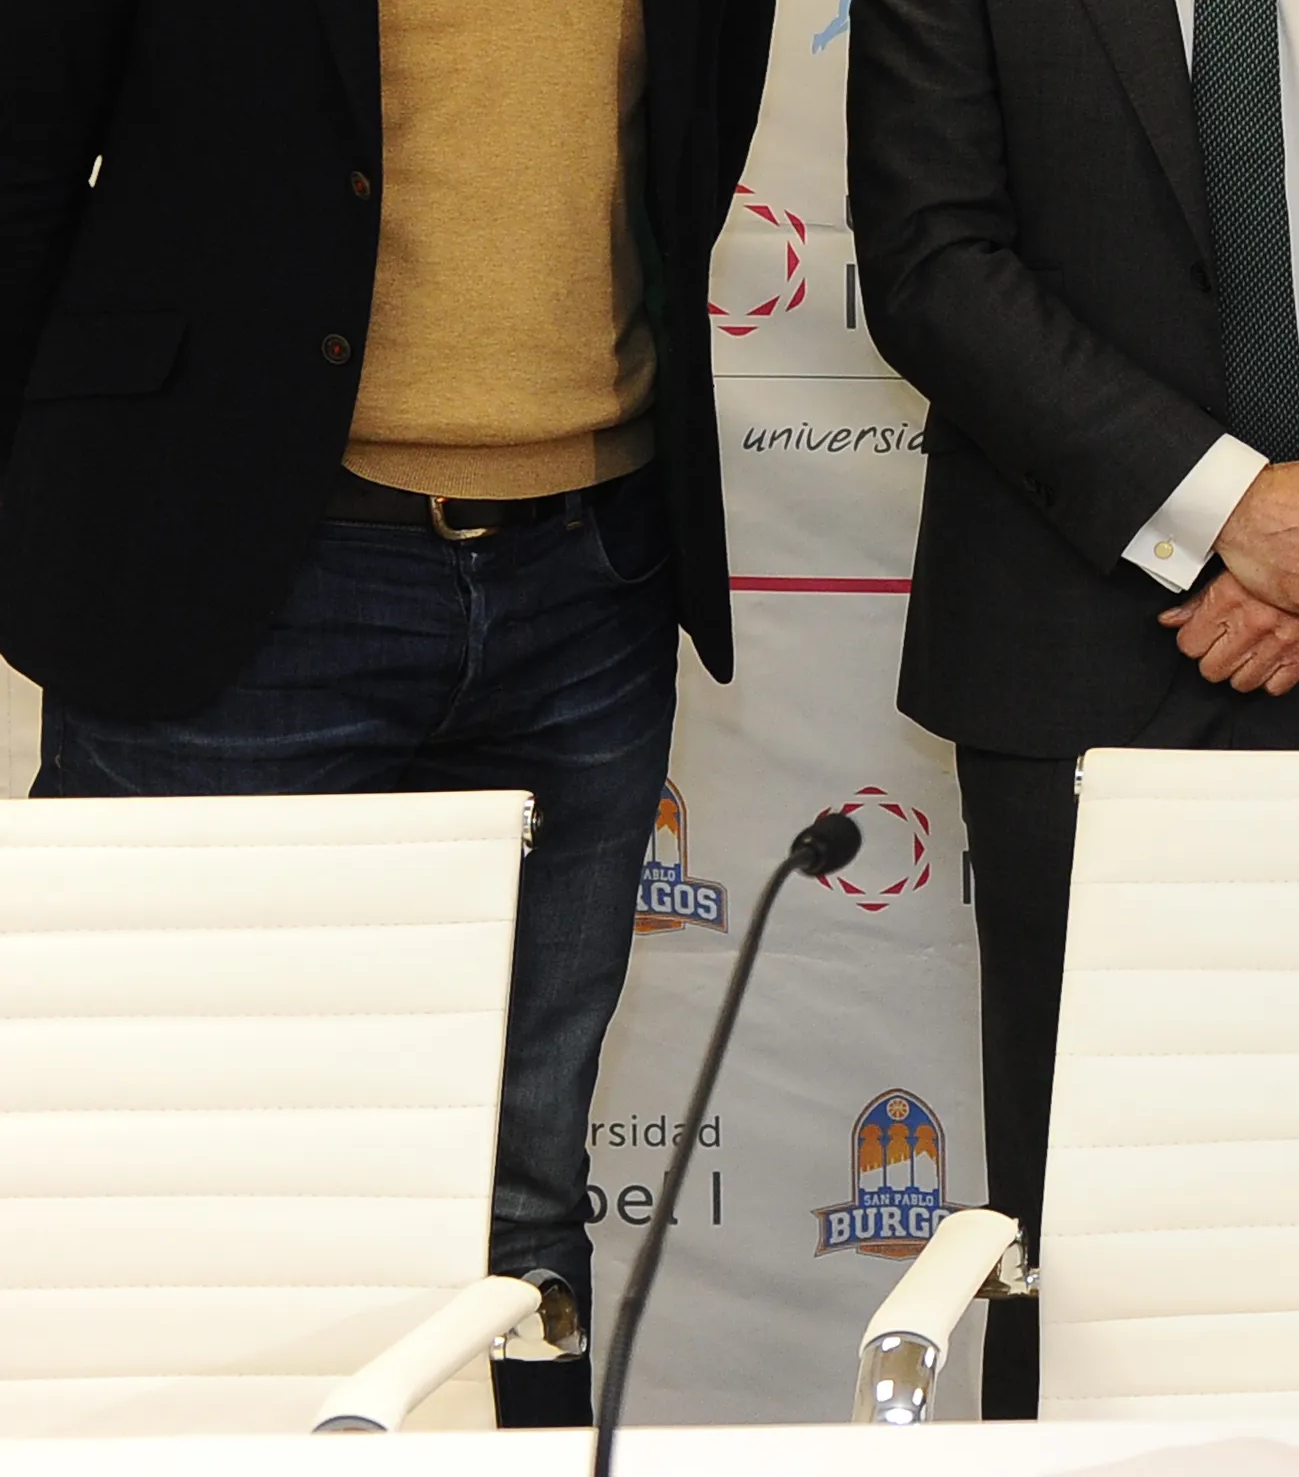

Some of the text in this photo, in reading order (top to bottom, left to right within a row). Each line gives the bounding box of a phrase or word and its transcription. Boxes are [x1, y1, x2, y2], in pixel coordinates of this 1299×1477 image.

[643, 868, 677, 882] ABLO
[864, 1193, 934, 1207] SAN PABLO
